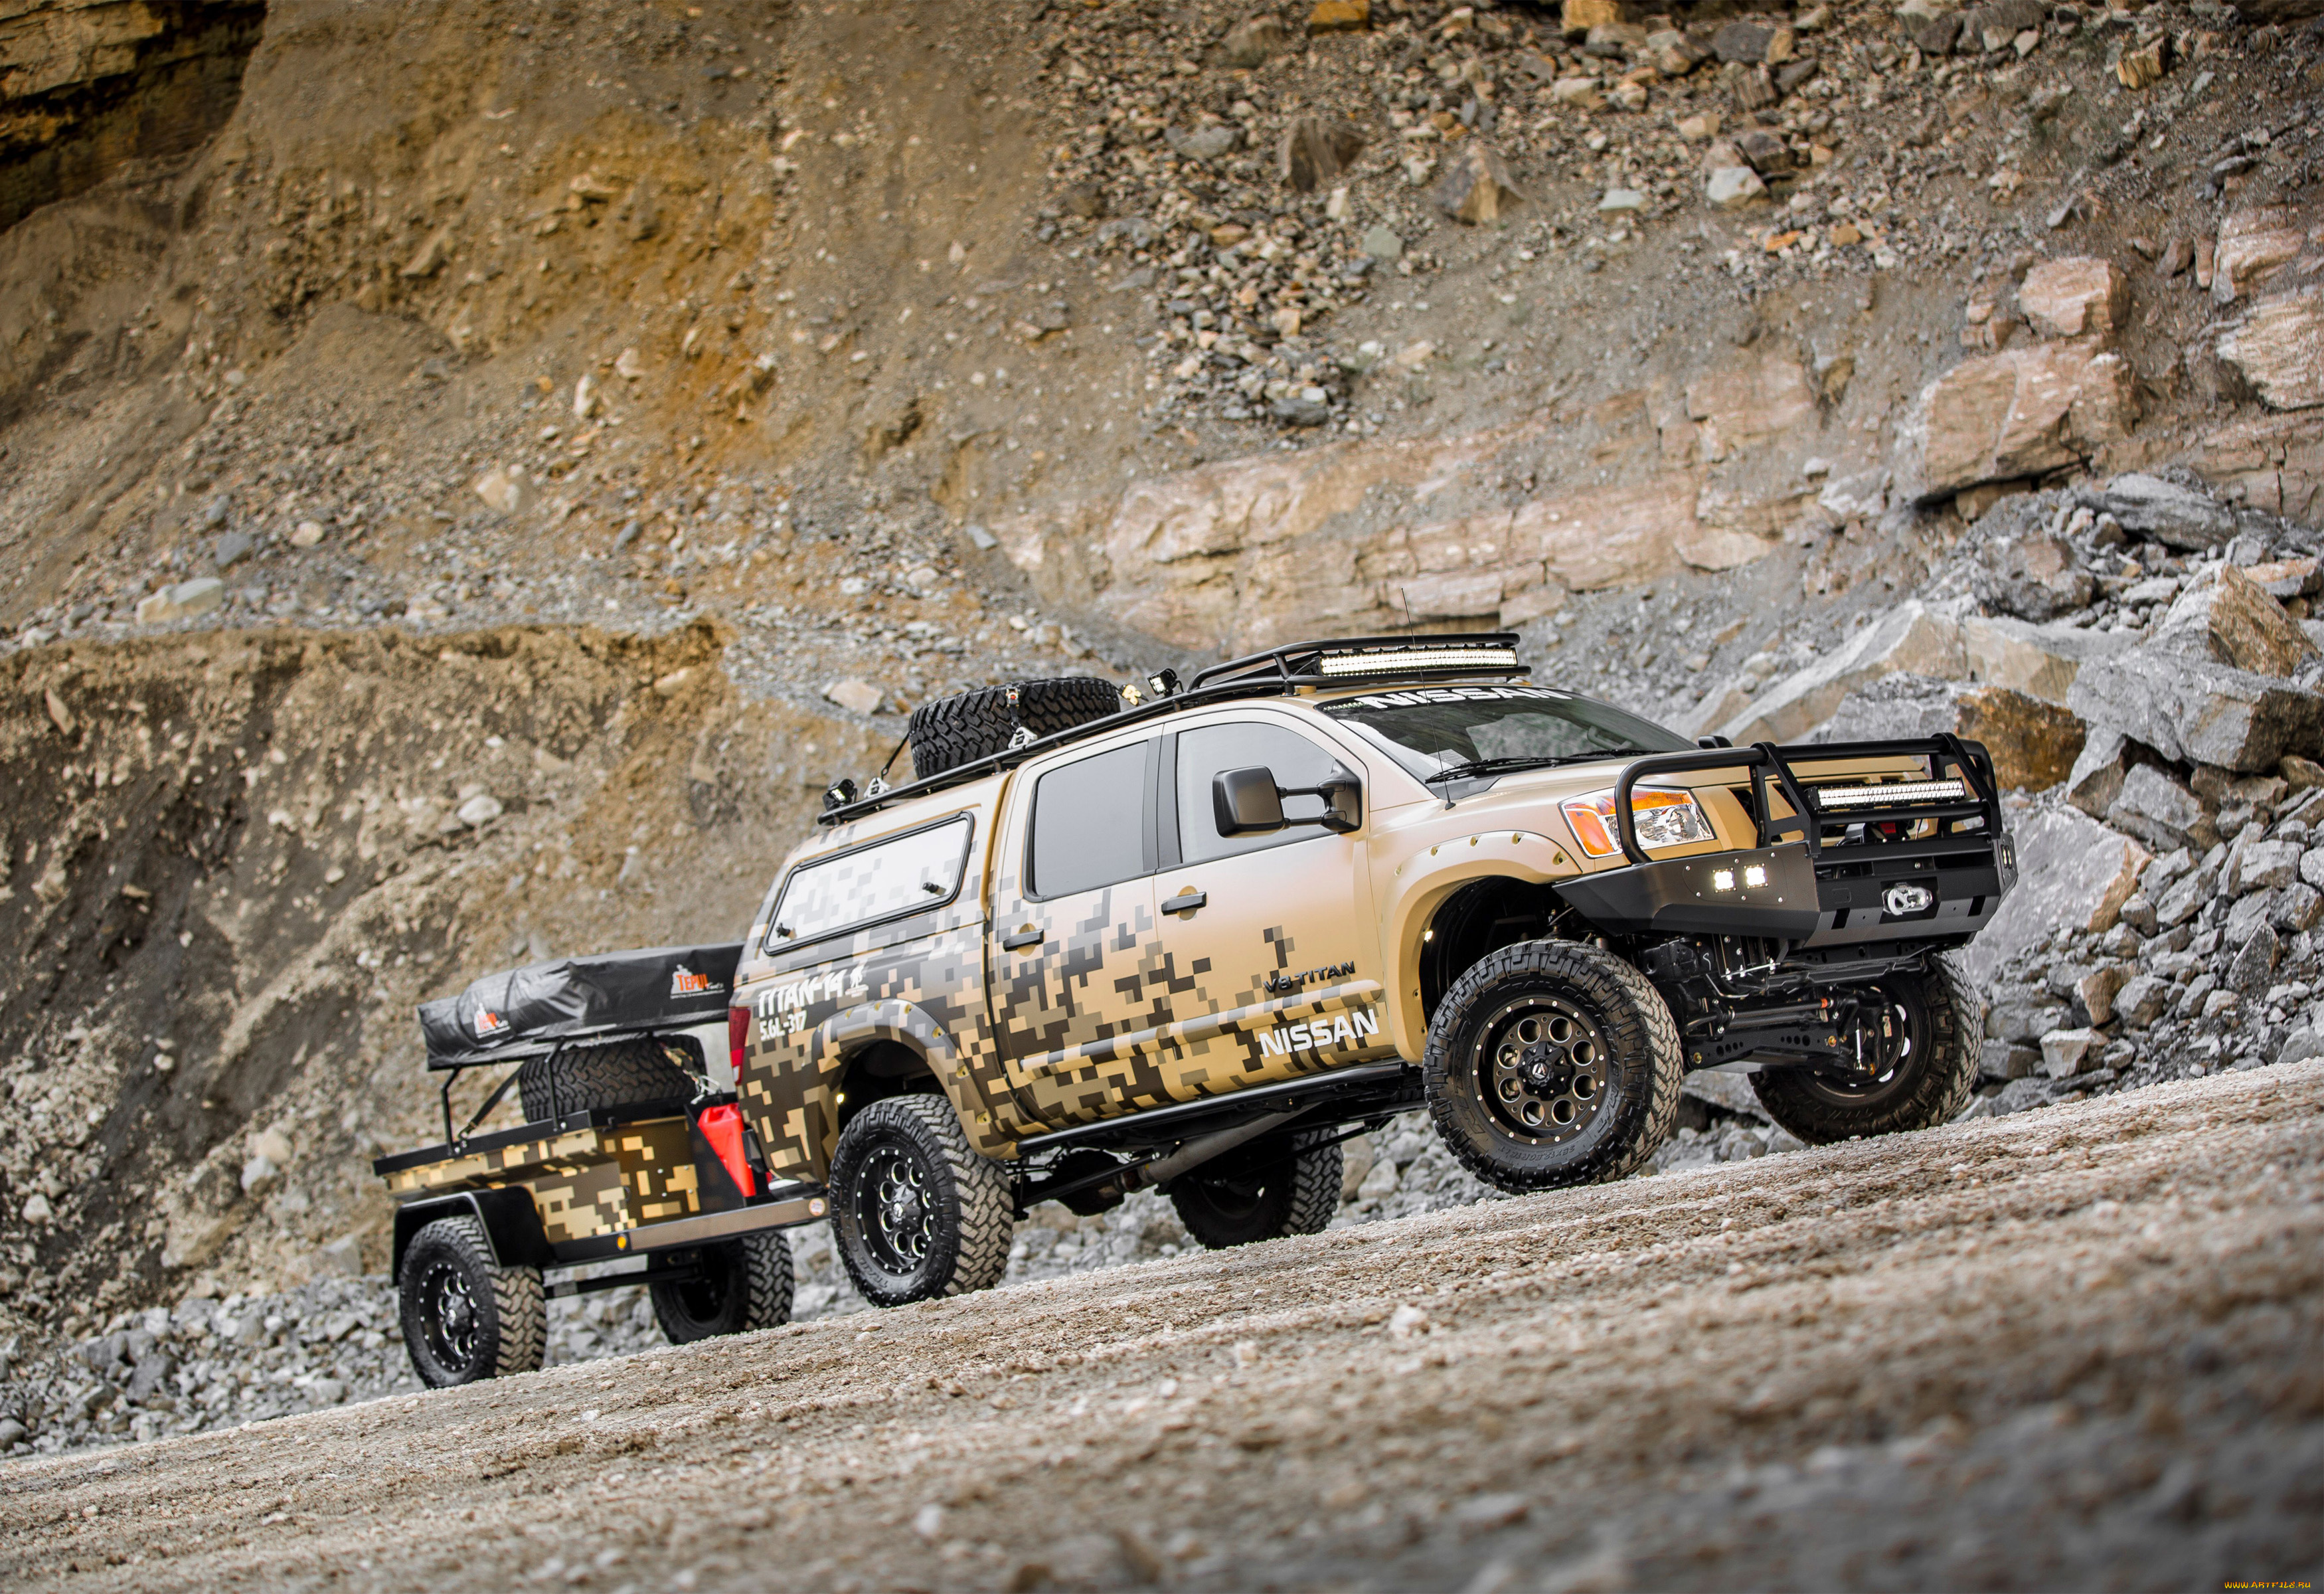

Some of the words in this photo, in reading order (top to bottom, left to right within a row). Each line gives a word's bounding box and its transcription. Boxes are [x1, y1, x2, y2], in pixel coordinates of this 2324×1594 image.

[1354, 687, 1572, 709] NISSAN
[1262, 975, 1293, 993] V8
[1295, 960, 1356, 986] TITAN
[1258, 1008, 1380, 1058] NISSAN
